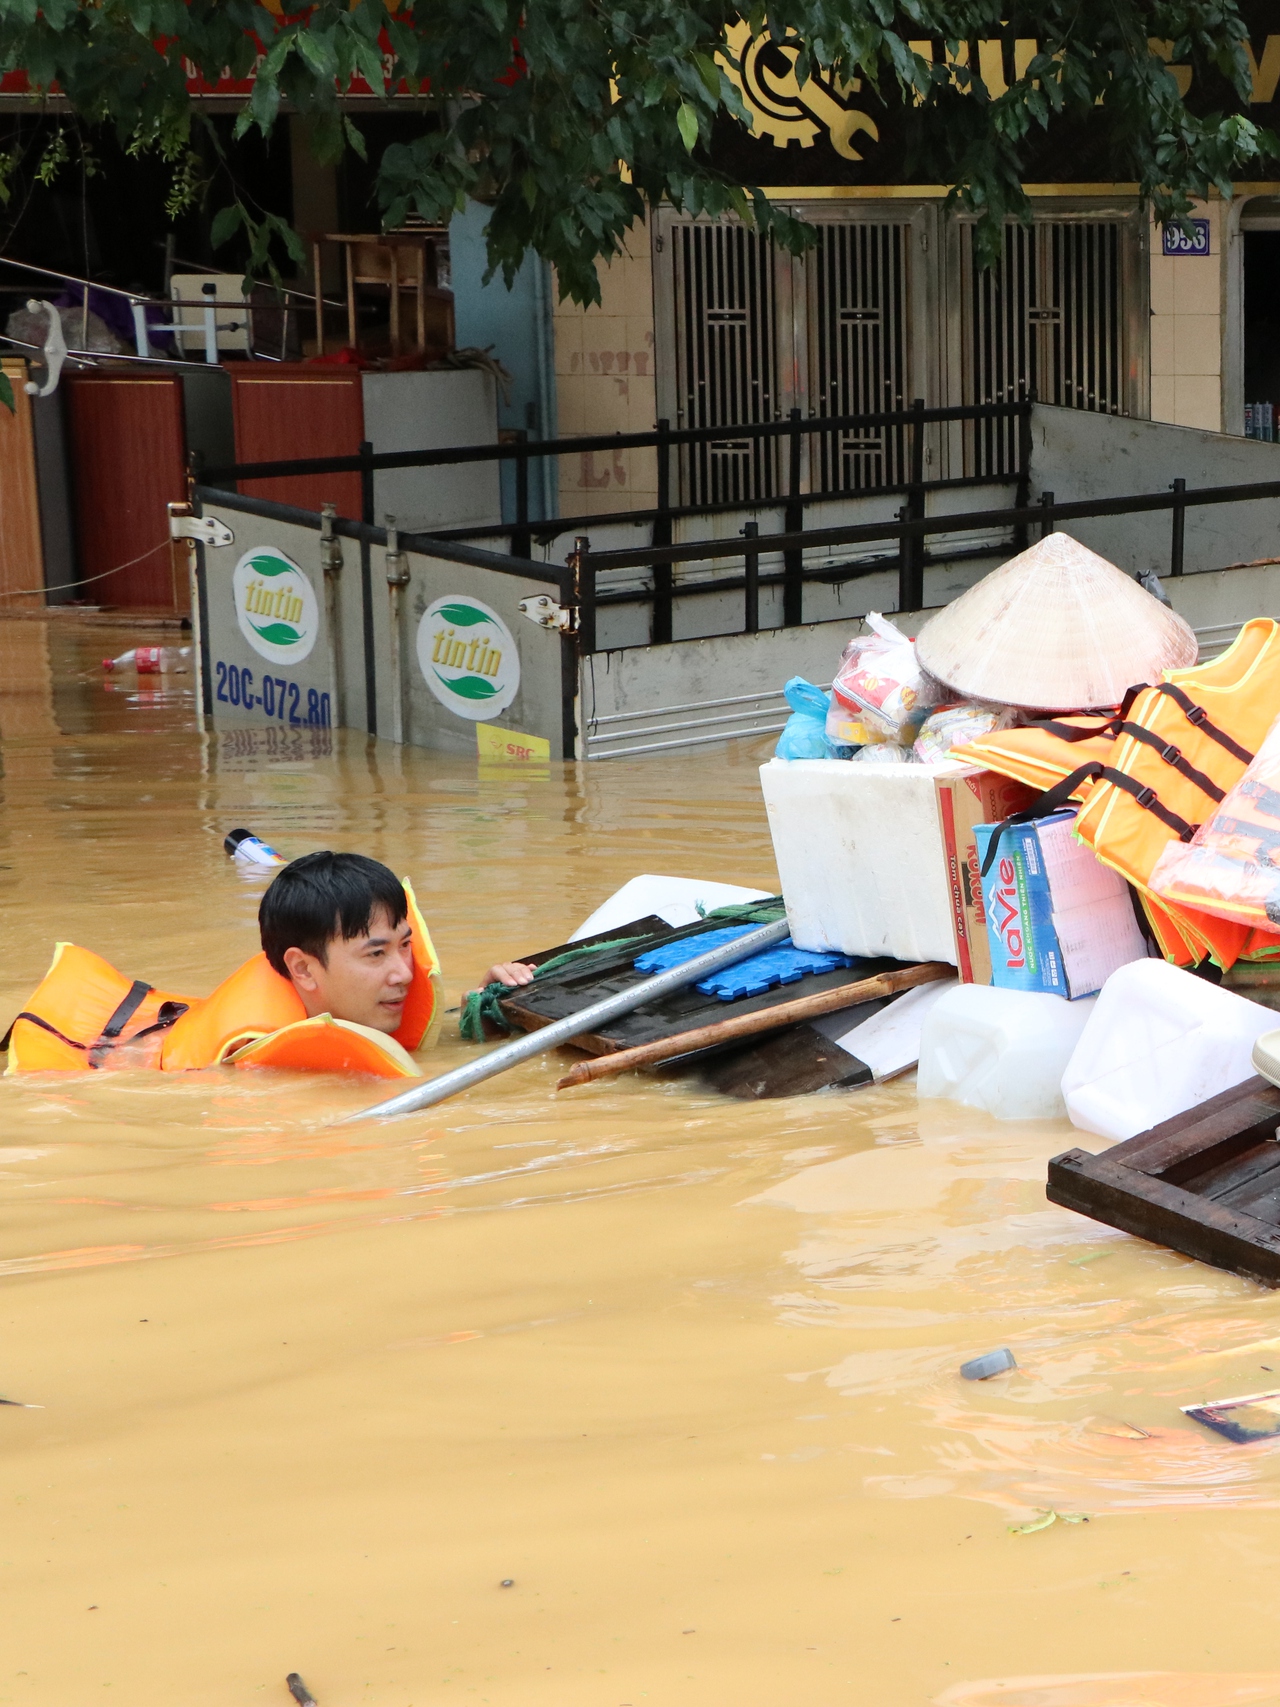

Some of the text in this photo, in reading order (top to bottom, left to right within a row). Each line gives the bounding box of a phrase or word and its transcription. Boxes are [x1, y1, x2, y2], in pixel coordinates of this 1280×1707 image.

[1166, 226, 1206, 250] 956
[245, 579, 303, 623] tintin
[432, 629, 502, 677] tintin
